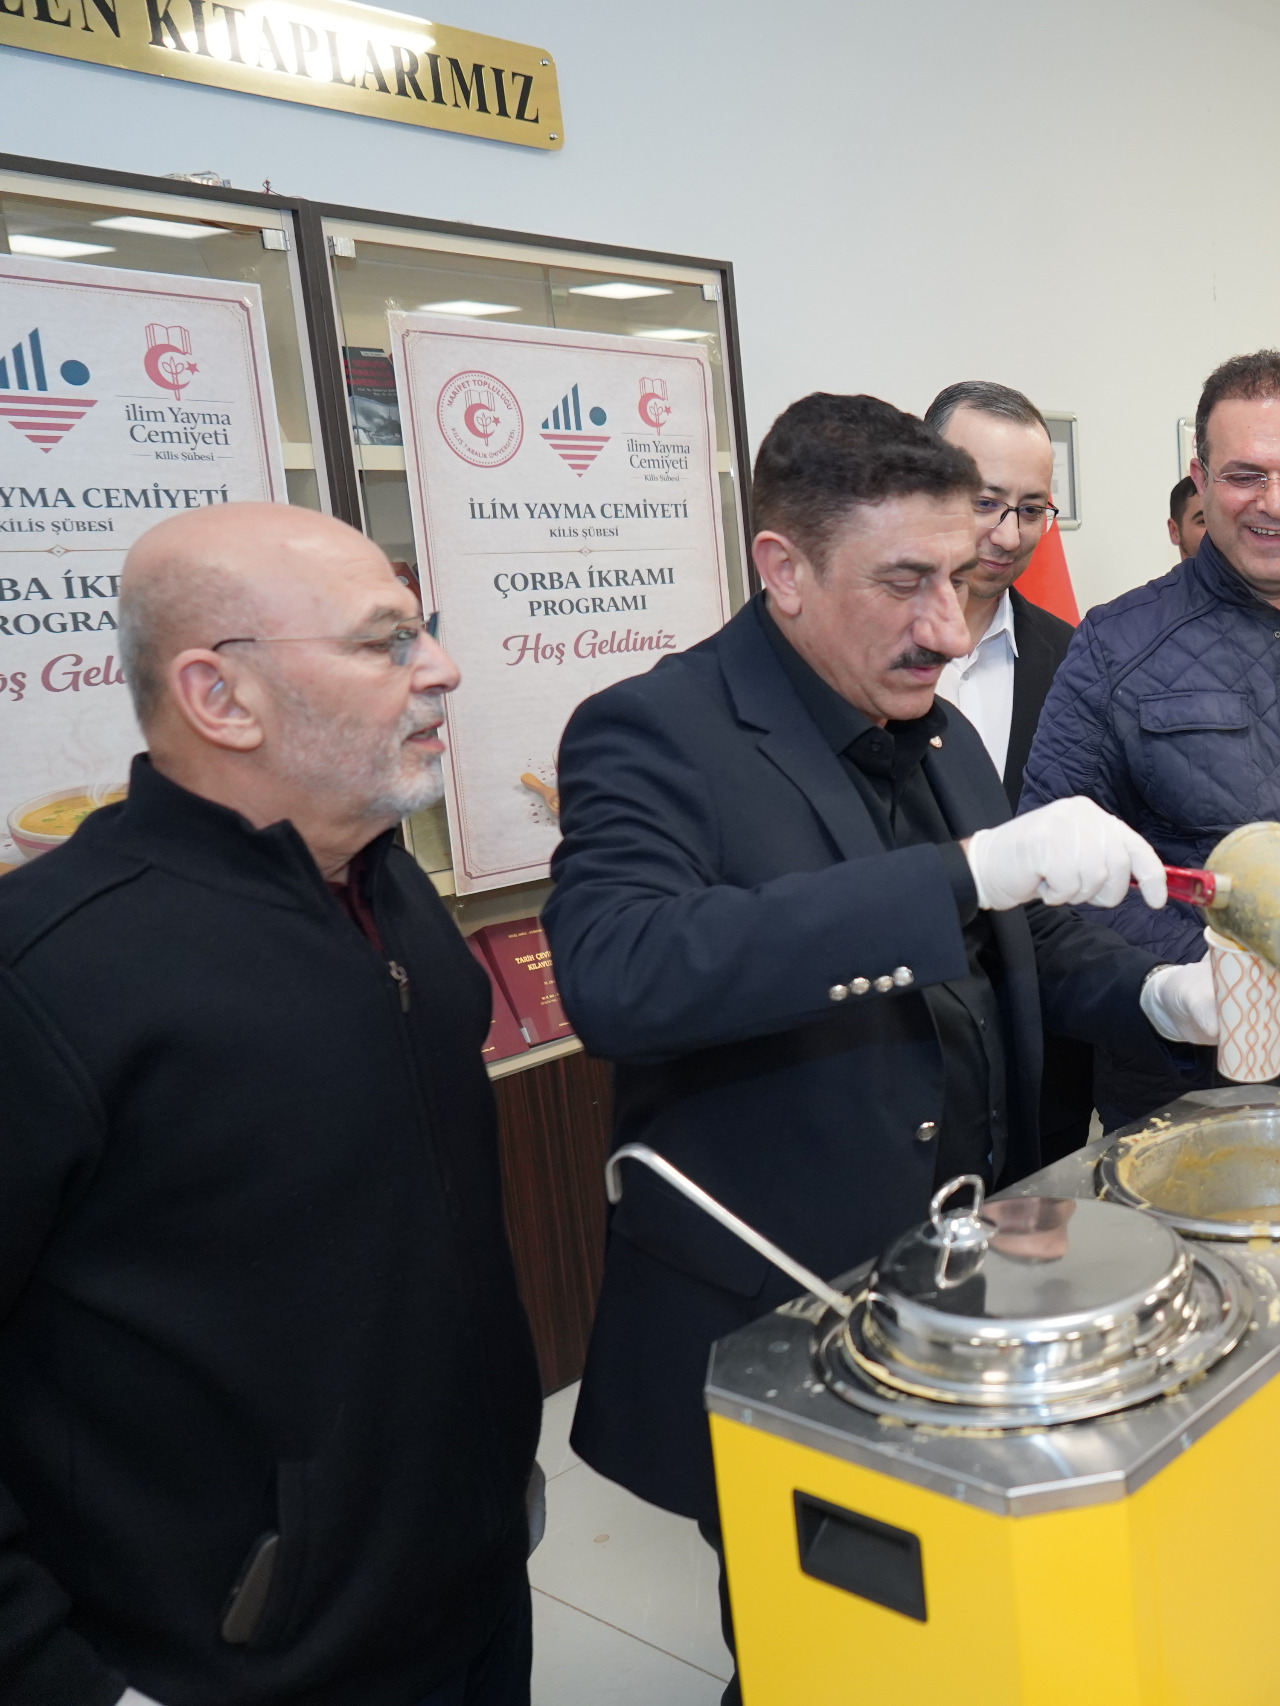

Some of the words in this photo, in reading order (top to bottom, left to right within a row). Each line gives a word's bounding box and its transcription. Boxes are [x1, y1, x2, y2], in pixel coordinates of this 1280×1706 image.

[125, 404, 165, 422] ilim
[167, 406, 232, 430] Yayma
[129, 424, 230, 451] Cemiyeti
[627, 438, 651, 453] ilim
[652, 440, 690, 458] Yayma
[155, 451, 179, 461] Kilis
[629, 454, 688, 474] Cemiyeti
[524, 502, 597, 519] YAYMA
[549, 526, 579, 538] KİLİS
[493, 571, 582, 599] ÇORBA
[529, 595, 648, 617] PROGRAMI
[502, 632, 566, 666] Hoş
[573, 628, 677, 659] Geldiniz
